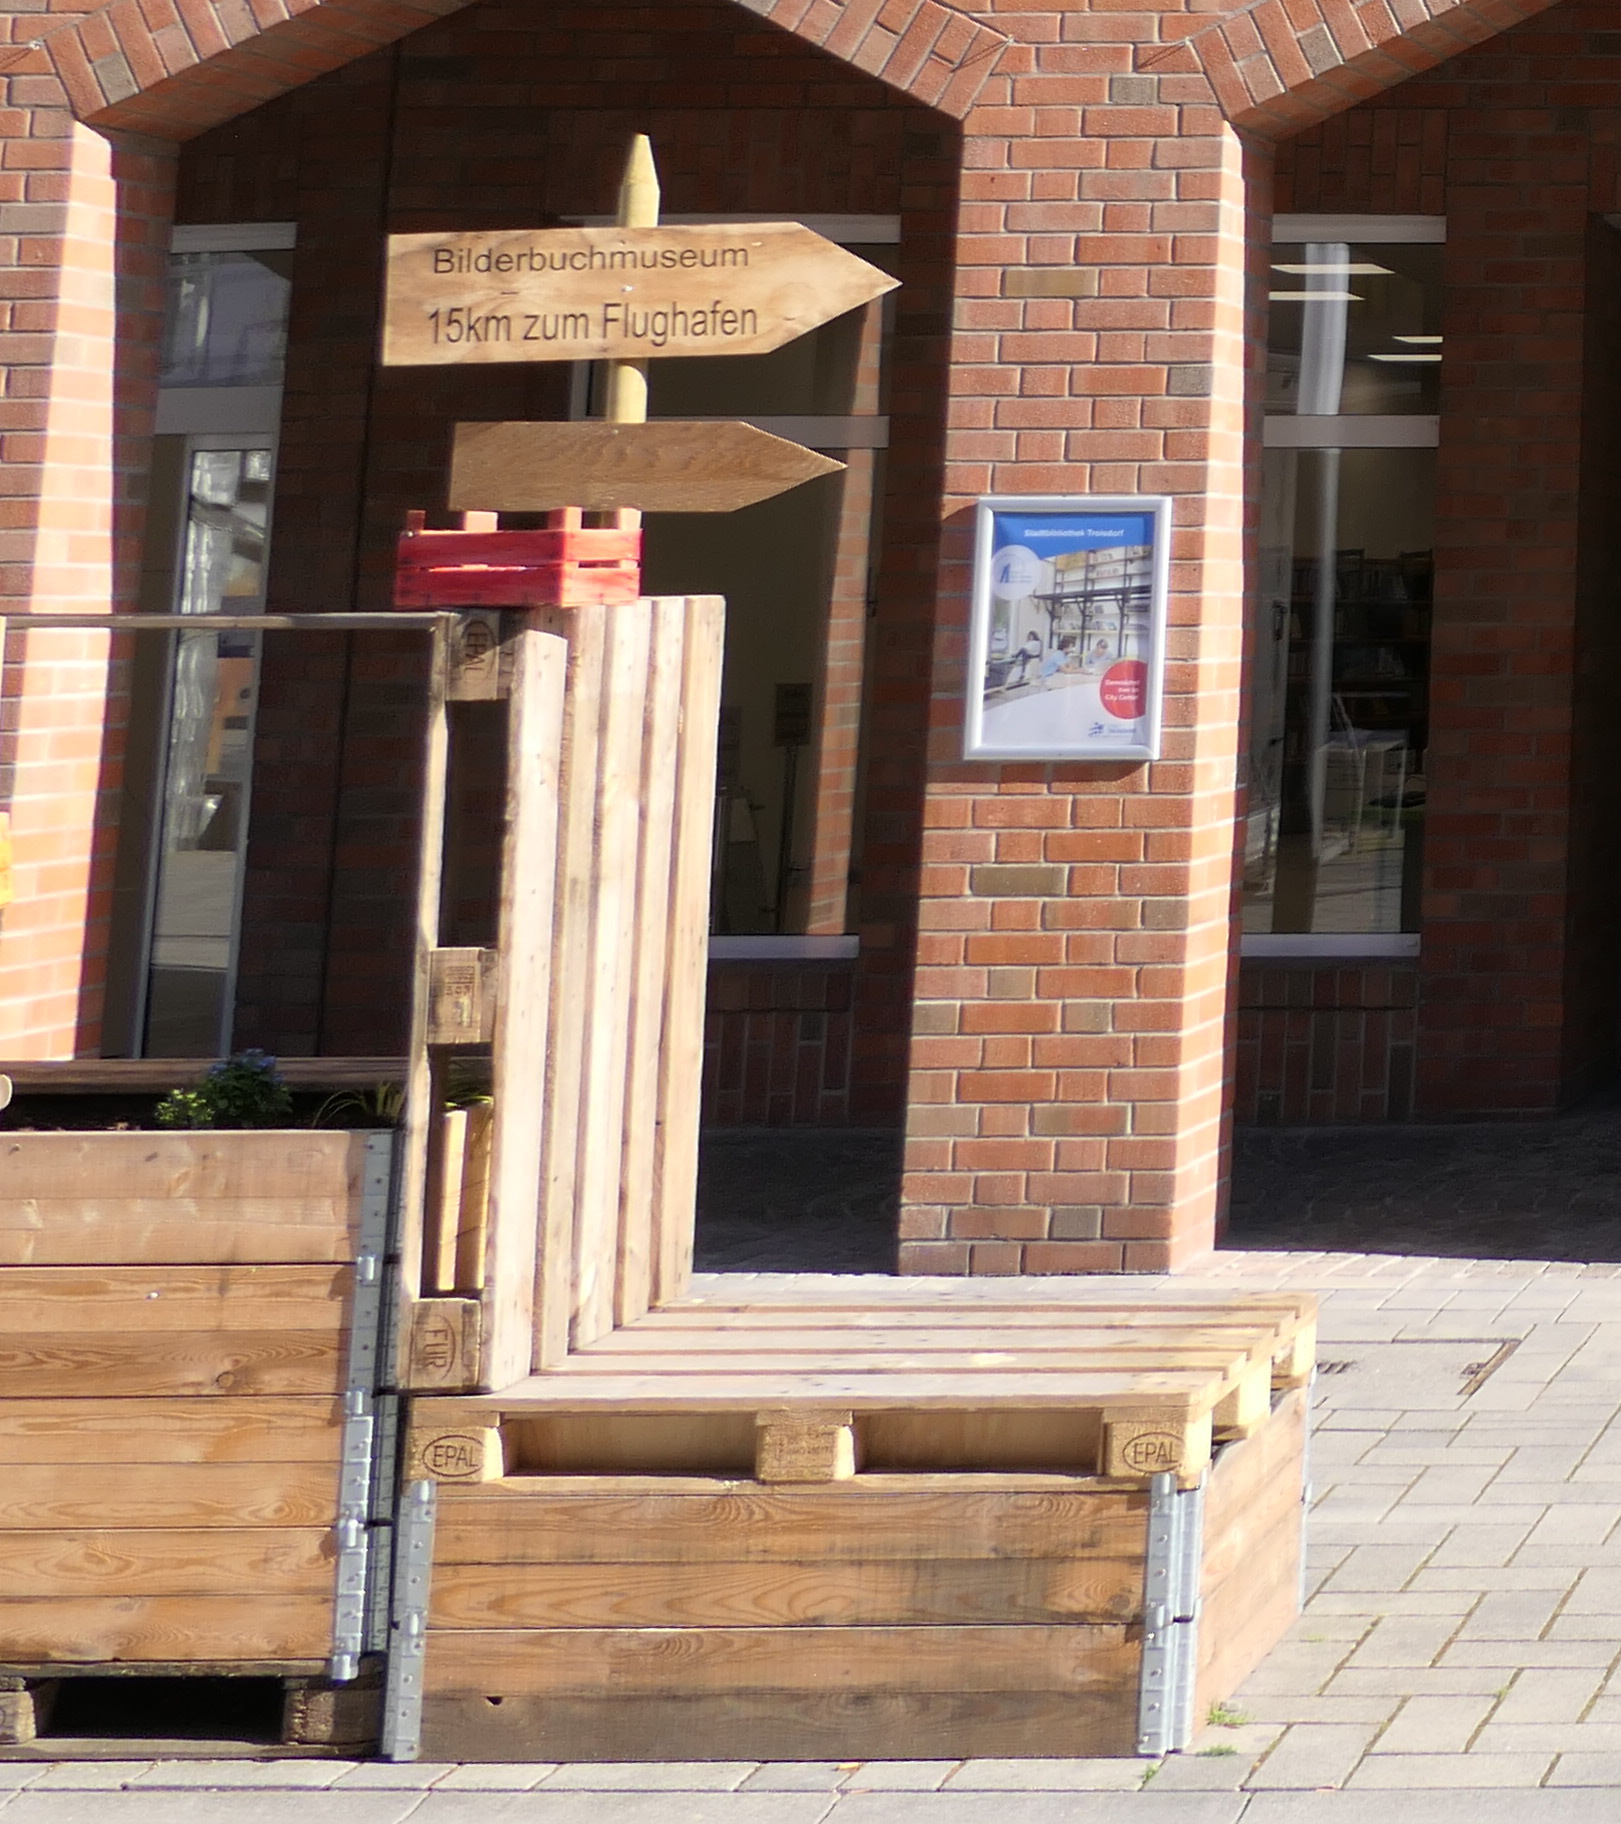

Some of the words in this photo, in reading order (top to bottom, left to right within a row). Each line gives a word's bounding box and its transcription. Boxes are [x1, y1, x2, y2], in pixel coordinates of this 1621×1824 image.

[433, 245, 749, 274] Bilderbuchmuseum
[428, 307, 512, 344] 15km
[523, 311, 590, 341] zum
[602, 299, 758, 347] Flughafen
[432, 1443, 479, 1469] EPAL
[1133, 1441, 1179, 1465] EPAL
